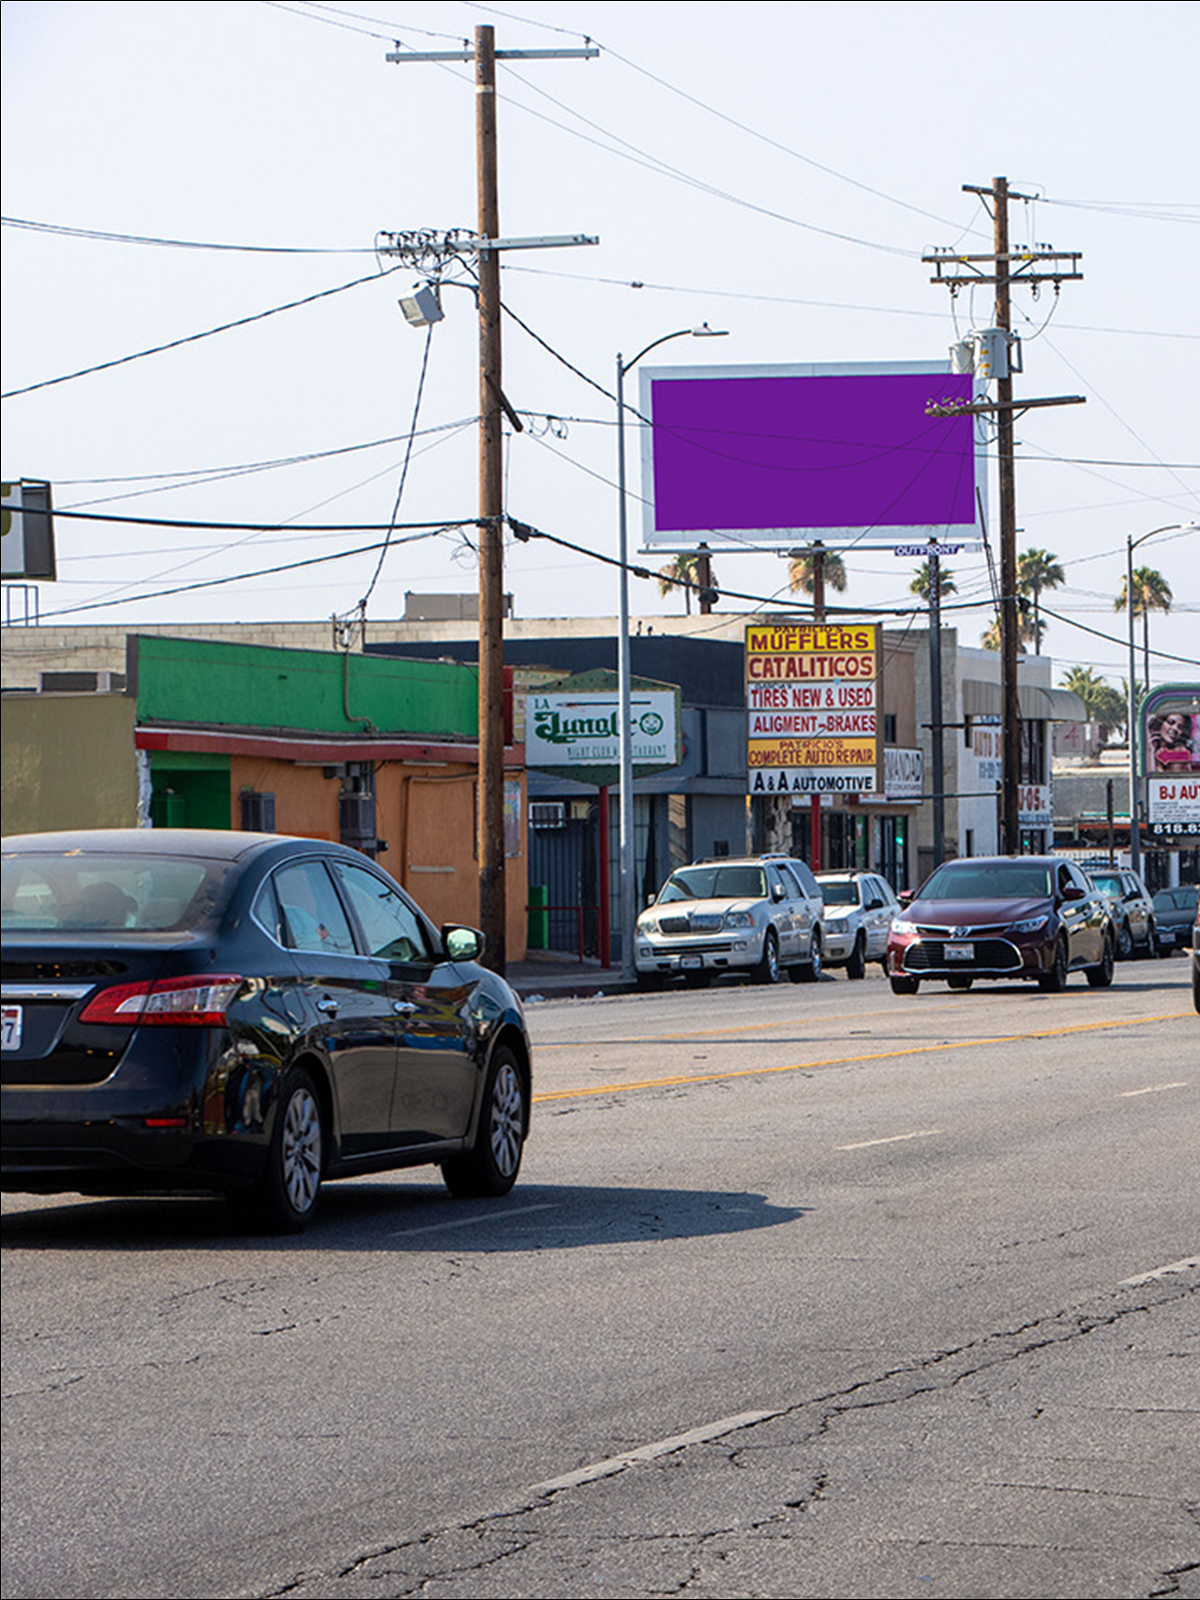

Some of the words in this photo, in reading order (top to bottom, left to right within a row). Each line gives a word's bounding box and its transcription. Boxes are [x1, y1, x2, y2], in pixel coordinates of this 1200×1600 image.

[896, 545, 956, 555] OUTFRONT
[750, 633, 869, 651] MUFFLERS
[749, 656, 873, 678] CATALITICOS
[534, 698, 550, 709] LA
[751, 688, 788, 708] TIRES
[792, 688, 822, 708] NEW
[825, 687, 835, 707] &
[838, 687, 873, 707] USED
[779, 740, 844, 750] PATRICIO'S
[748, 750, 802, 765] COMPLETE
[805, 749, 834, 764] AUTO
[836, 748, 874, 763] REPAIR
[754, 771, 765, 791] A
[767, 776, 775, 790] &
[777, 771, 789, 791] A
[792, 776, 873, 791] AUTOMOTIVE
[1159, 785, 1176, 800] BJ
